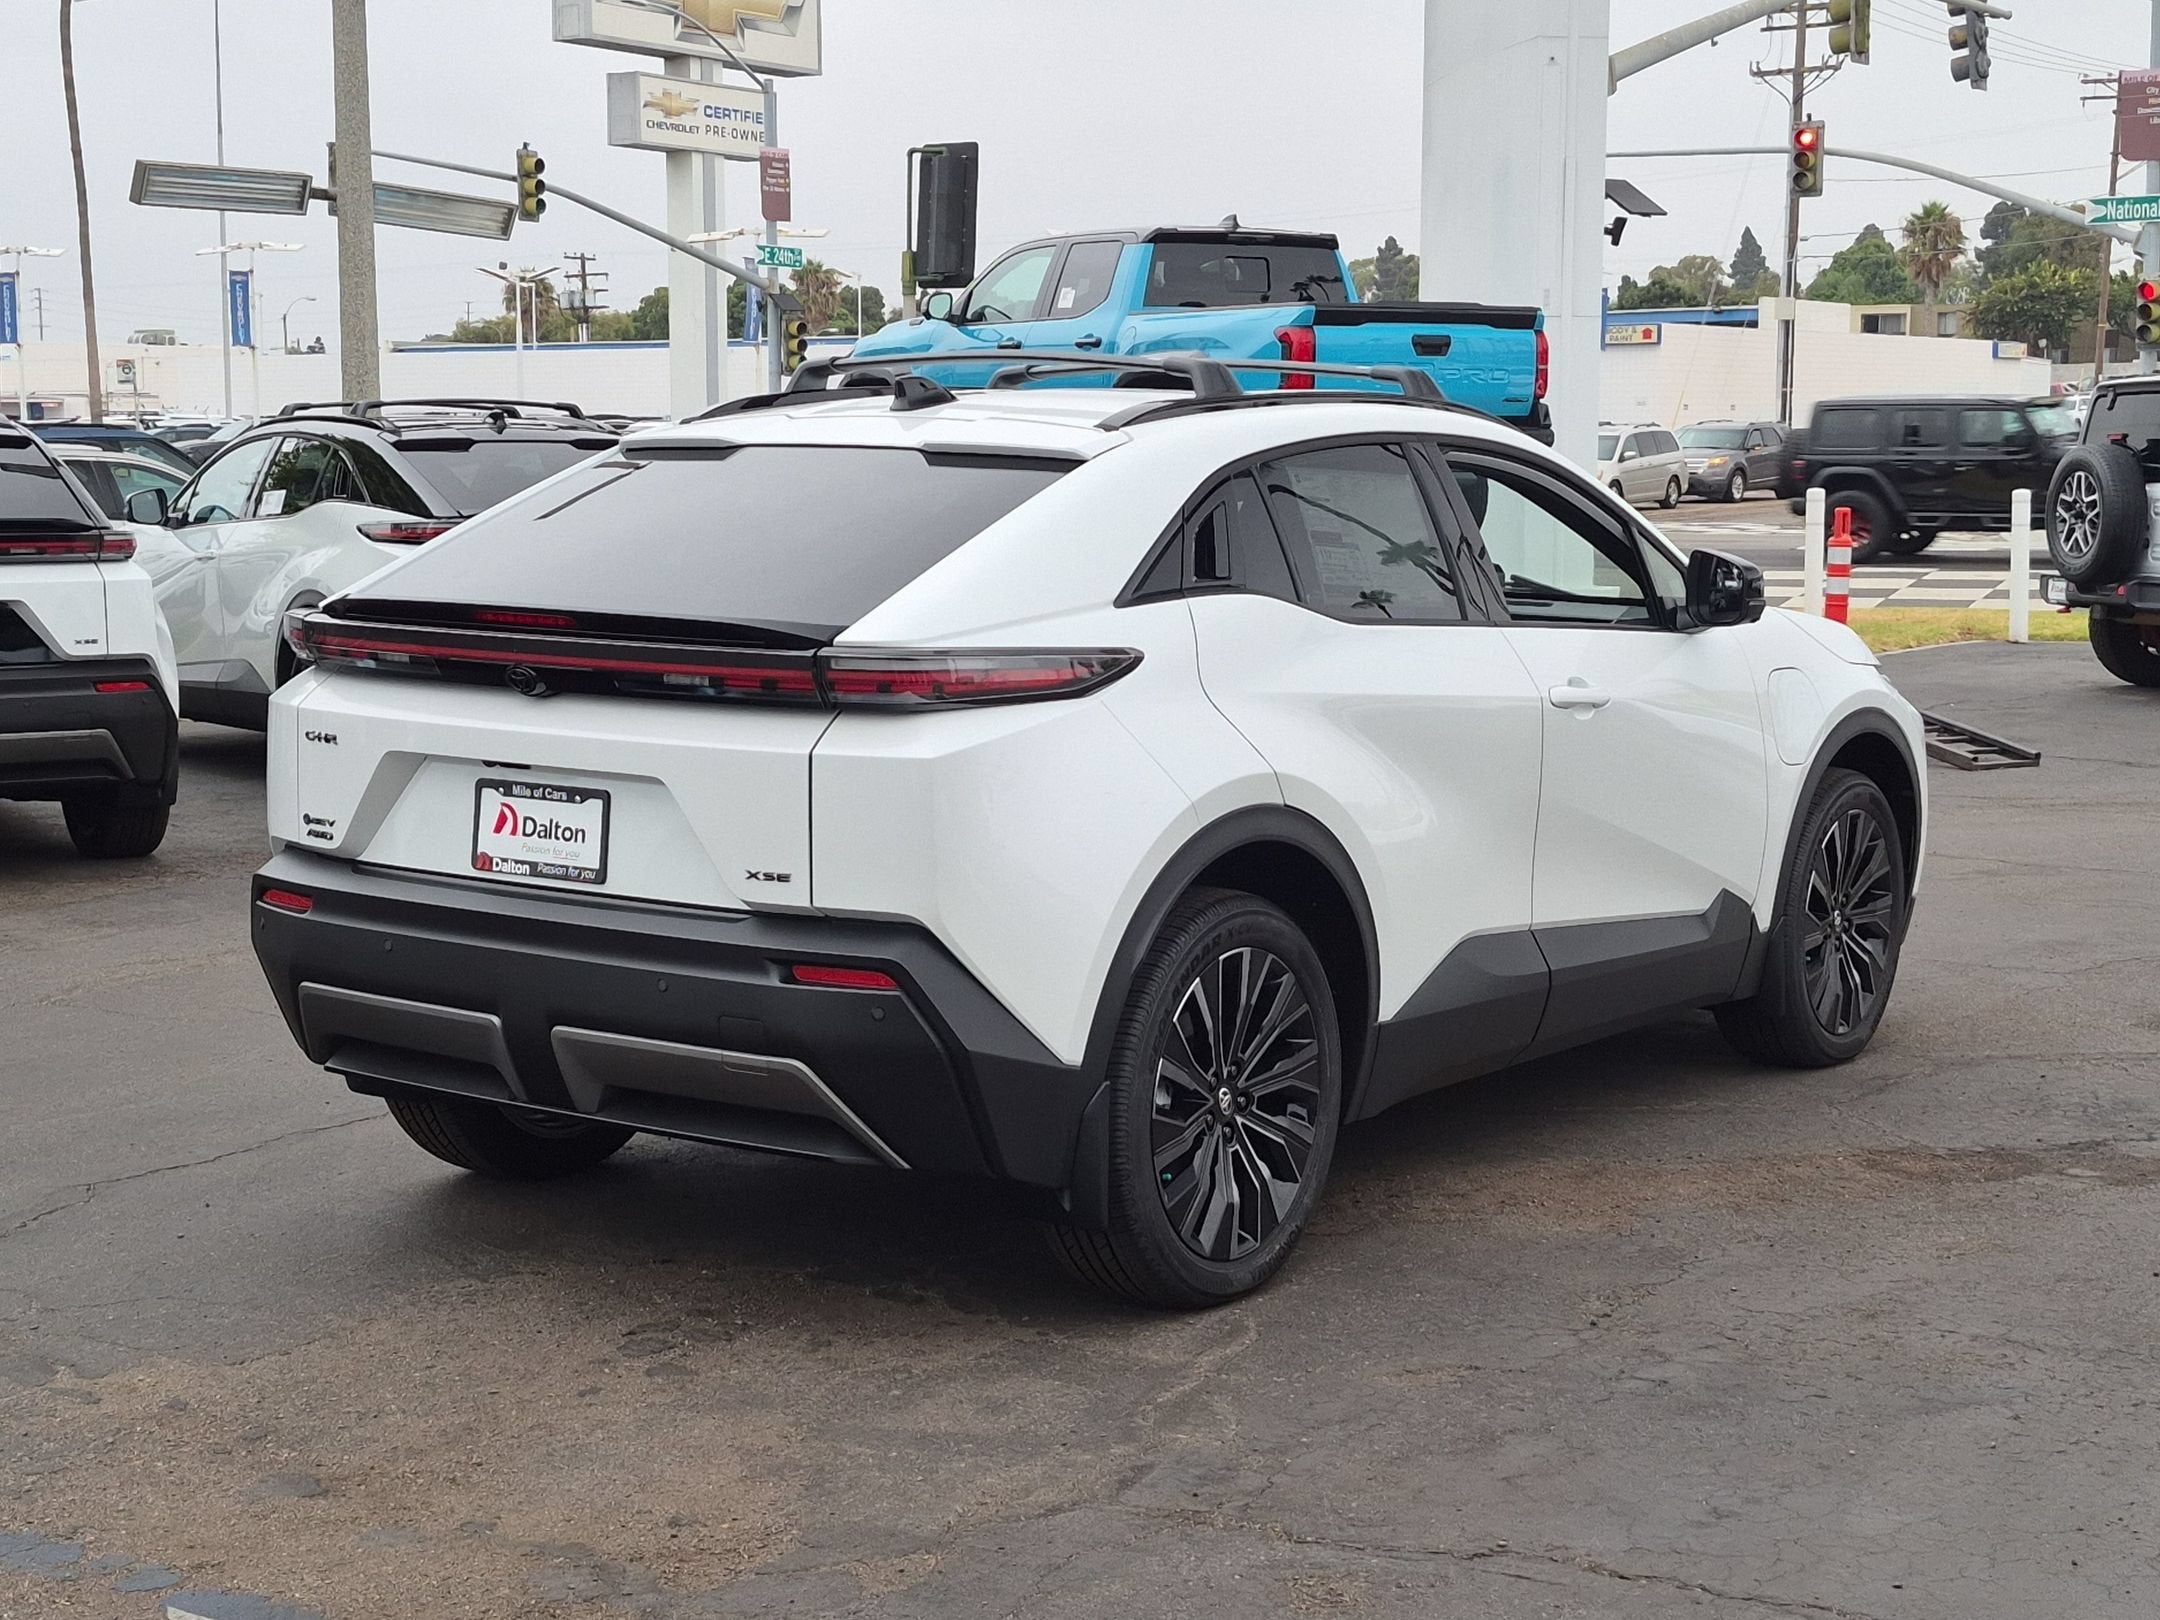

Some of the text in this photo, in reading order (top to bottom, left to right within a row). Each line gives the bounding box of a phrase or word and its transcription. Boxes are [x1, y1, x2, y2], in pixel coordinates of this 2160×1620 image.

[703, 104, 764, 125] CERTIFIE
[646, 119, 700, 135] CHEVROLET
[704, 124, 765, 143] PRE-OWNE
[764, 247, 773, 264] E
[773, 247, 794, 265] 24th
[1438, 367, 1511, 384] PRO
[512, 784, 567, 800] Mile of Cars
[521, 815, 586, 844] Dalton
[521, 842, 580, 859] Passion for you
[492, 857, 530, 875] Dalton
[537, 862, 596, 879] Passion for you
[744, 869, 792, 883] XSE
